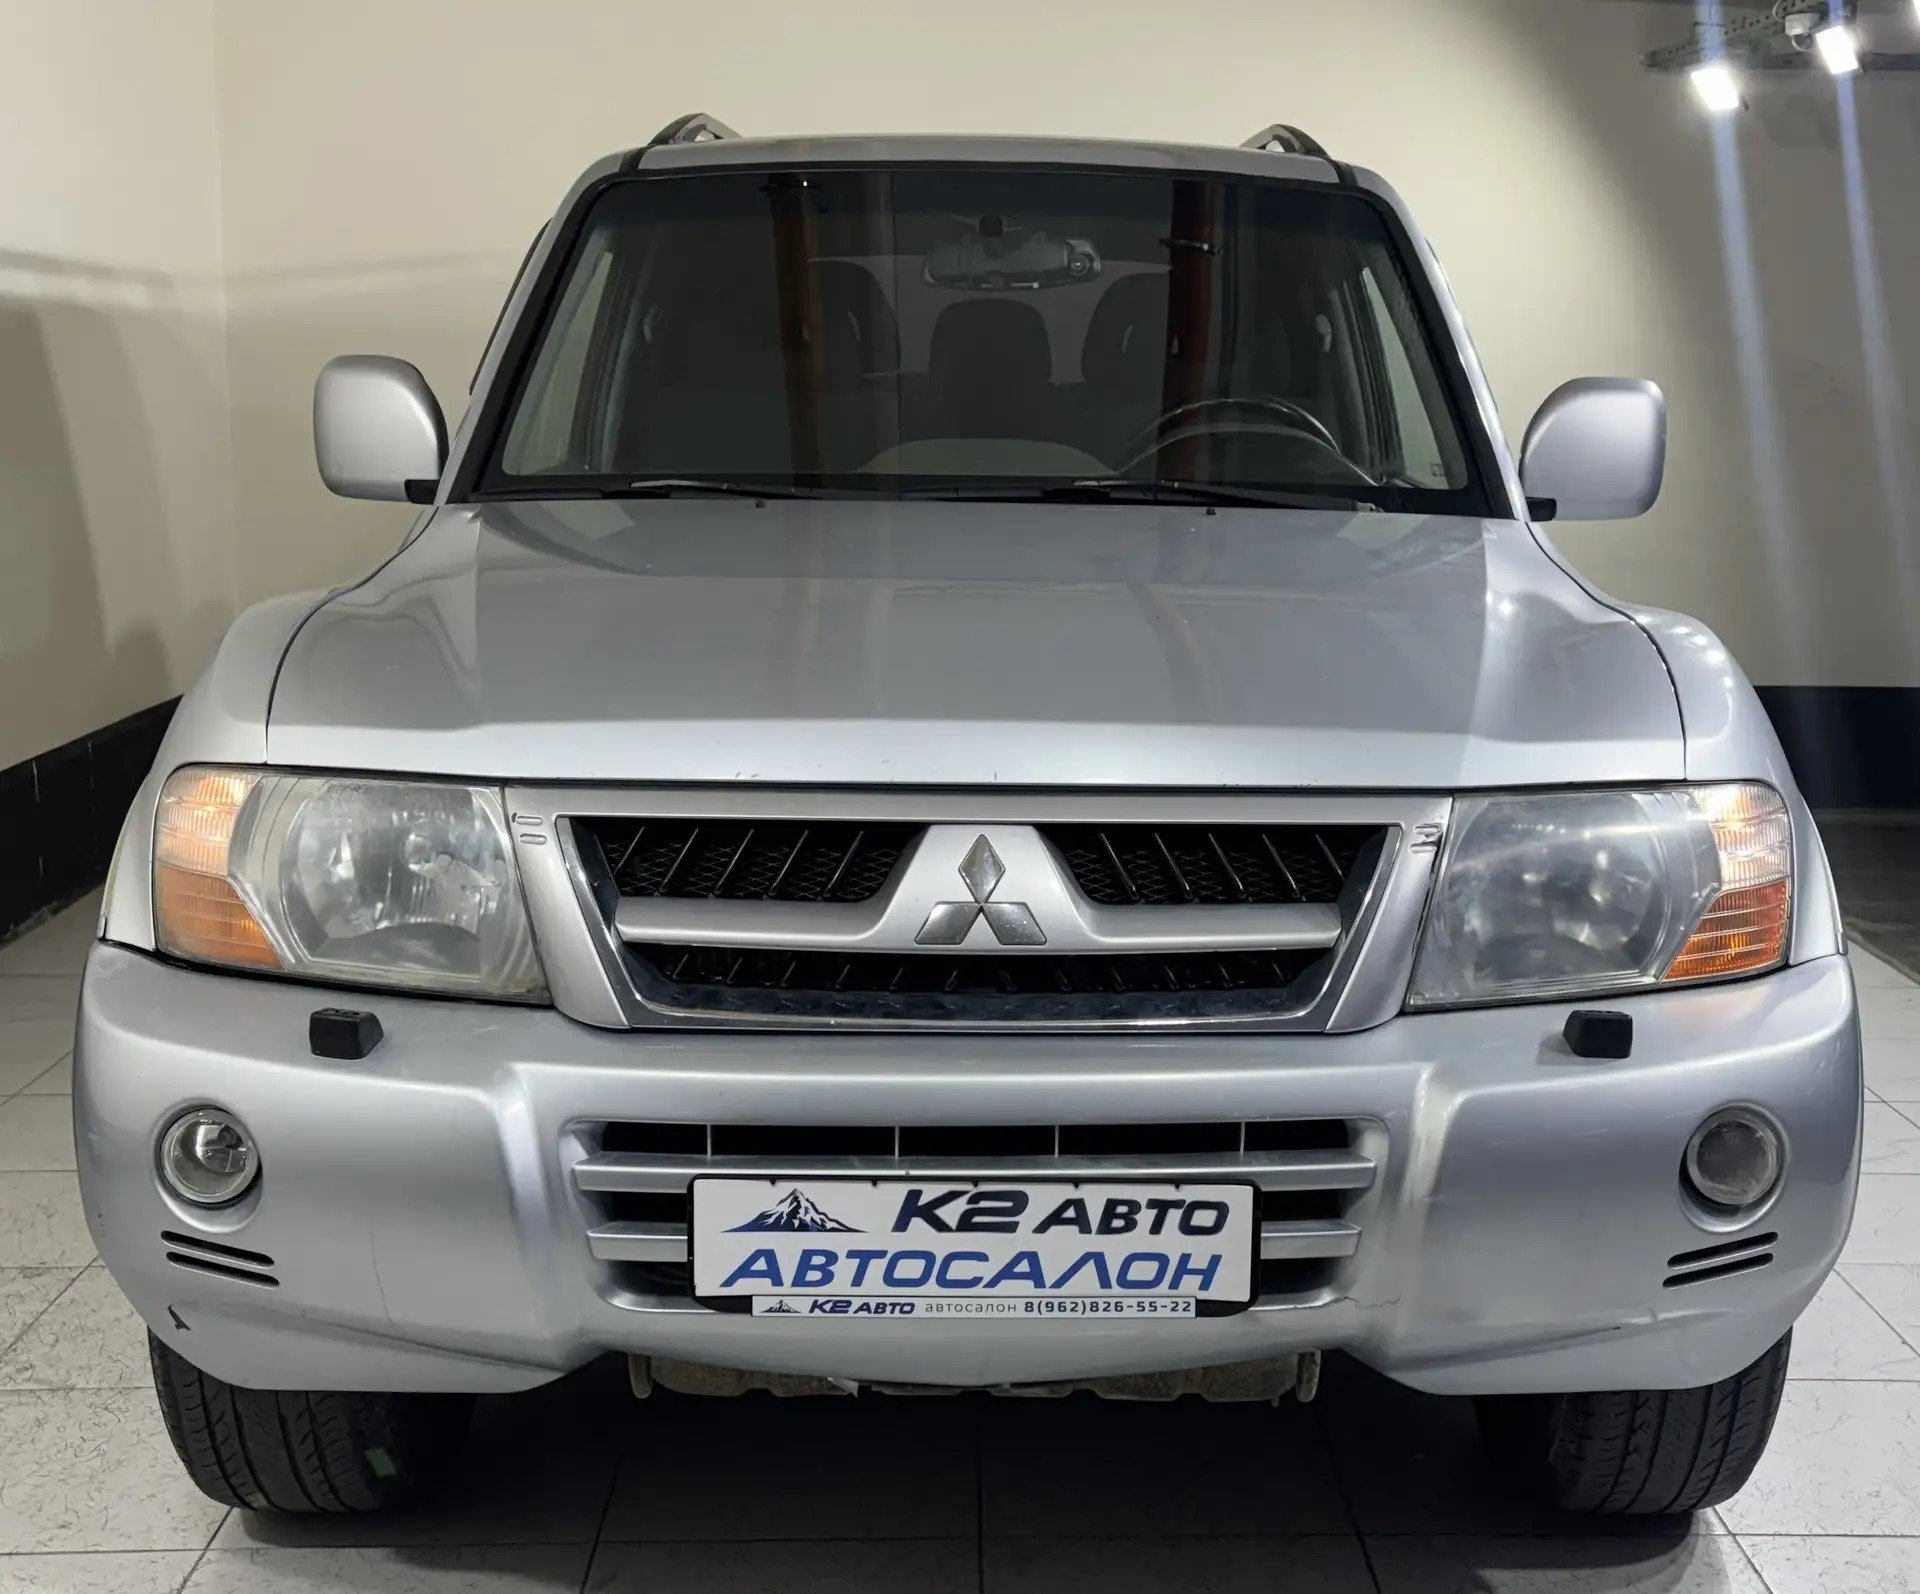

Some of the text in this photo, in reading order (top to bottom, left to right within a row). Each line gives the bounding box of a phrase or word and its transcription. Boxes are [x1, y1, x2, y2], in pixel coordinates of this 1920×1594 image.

[1032, 1198, 1230, 1236] АВТО
[719, 1248, 1222, 1291] АВТОСАЛОН
[853, 1302, 916, 1315] АВТО
[925, 1303, 1017, 1314] автосалон
[1023, 1300, 1192, 1315] 8(962)826-55-22
